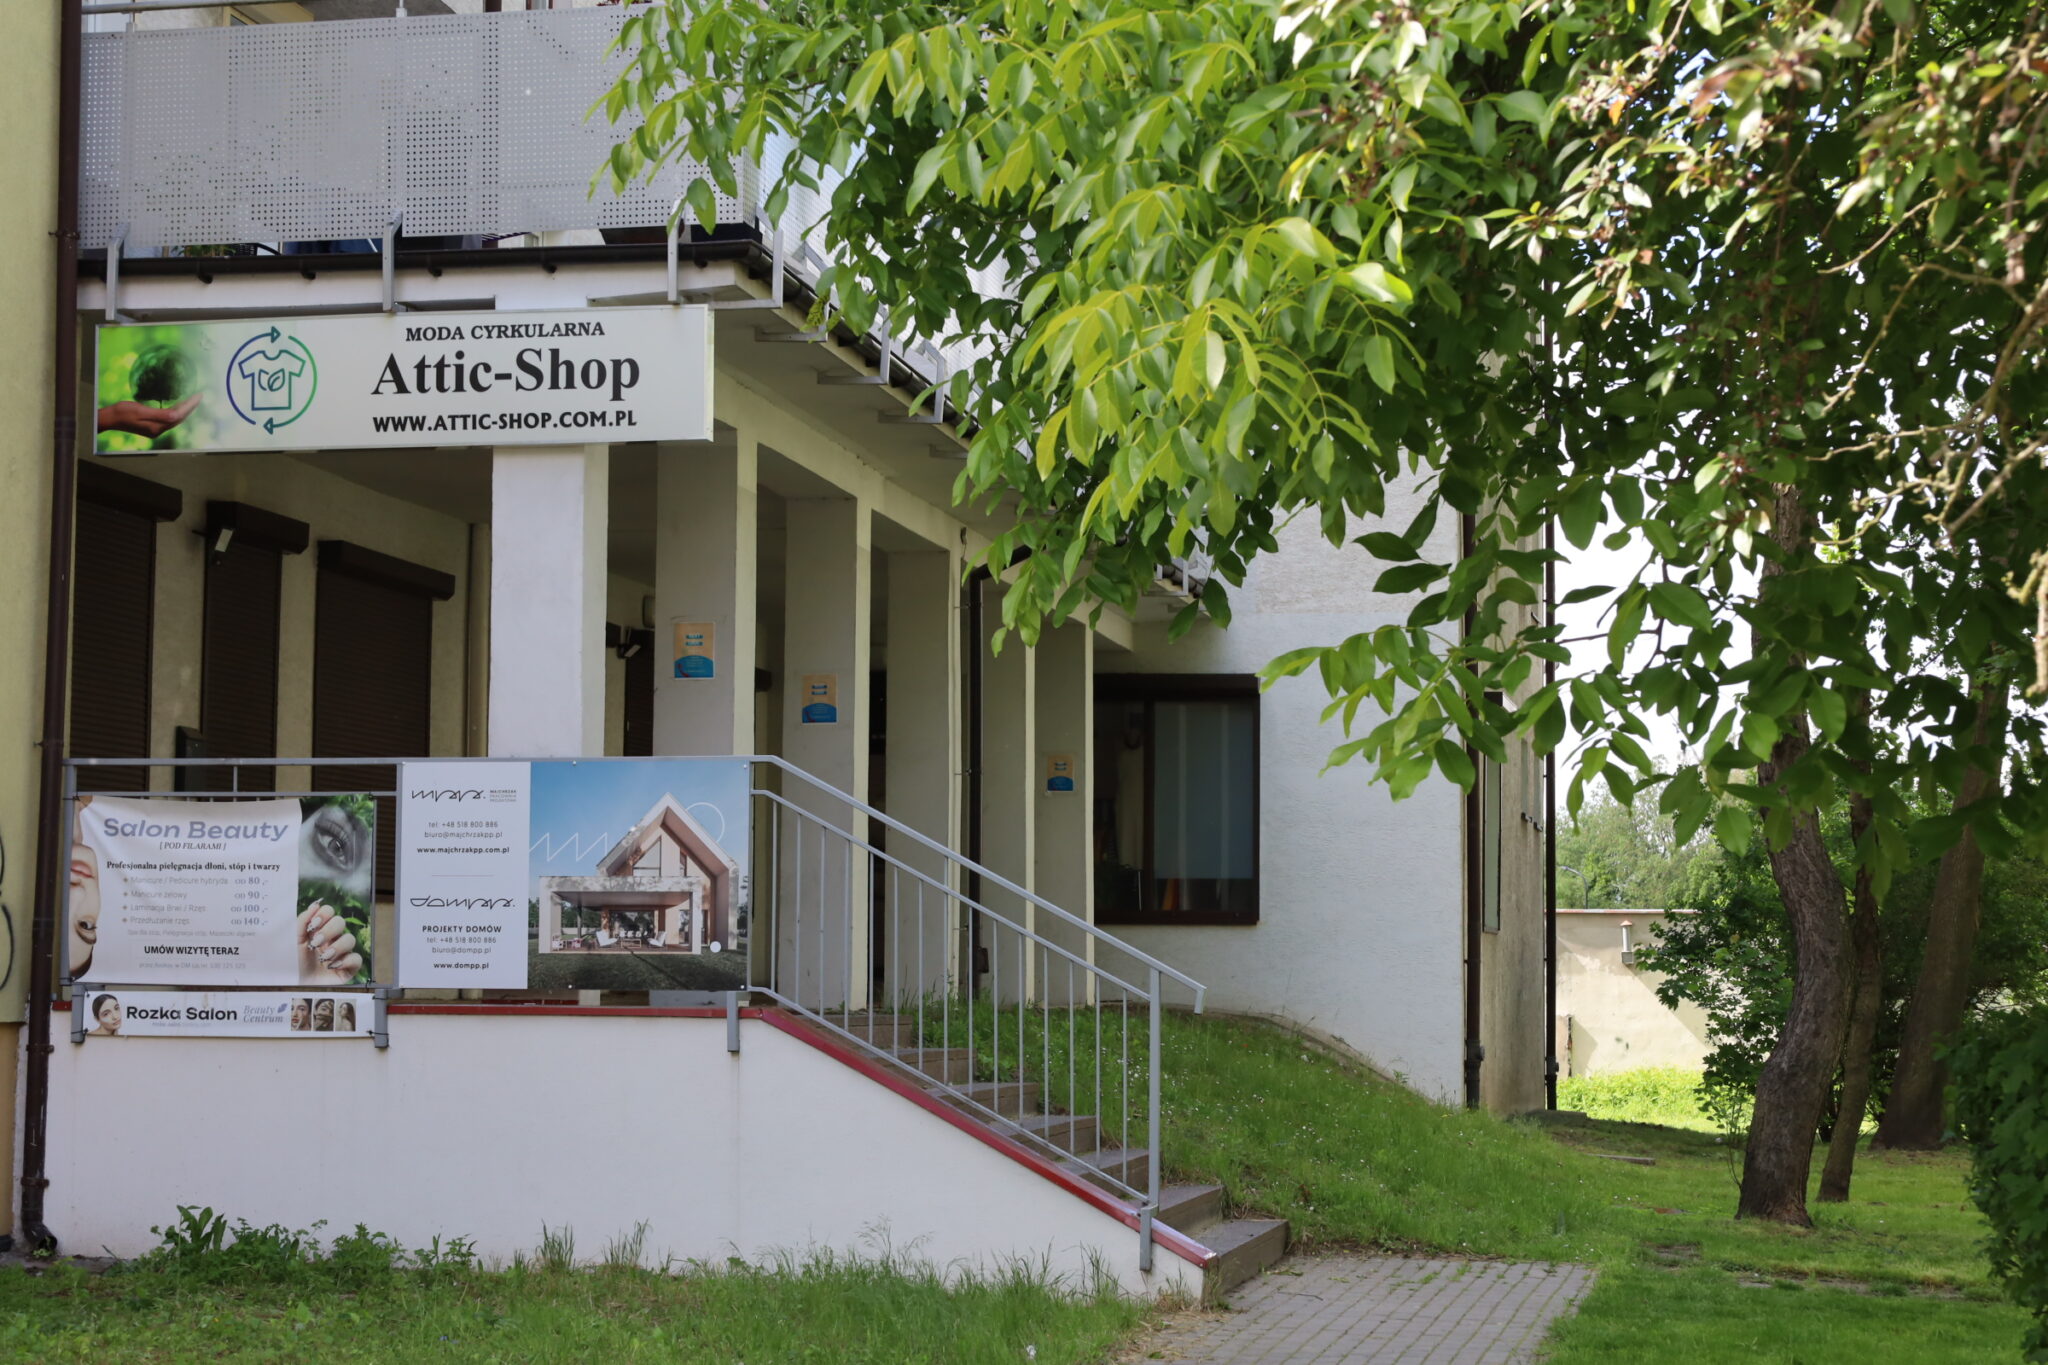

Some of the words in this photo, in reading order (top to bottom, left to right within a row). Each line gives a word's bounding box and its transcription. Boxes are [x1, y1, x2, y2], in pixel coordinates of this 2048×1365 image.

[406, 326, 465, 342] MODA
[470, 322, 606, 340] CYRKULARNA
[370, 347, 641, 402] Attic-Shop
[372, 410, 638, 433] WWW.ATTIC-SHOP.COM.PL
[103, 817, 181, 838] Salon
[187, 820, 289, 842] Beauty
[164, 842, 182, 850] POD
[182, 842, 222, 850] FILARAMI
[417, 846, 510, 854] www.majchrzakpp.com.pl
[106, 861, 157, 871] Profesjonalna
[159, 862, 203, 872] pielęgnacja
[204, 862, 227, 871] dłoni,
[229, 863, 246, 873] stóp
[253, 863, 281, 873] twarzy
[422, 925, 462, 933] PROJEKTY
[465, 924, 502, 933] DOMÓW
[144, 944, 175, 955] UMÓW
[175, 946, 210, 957] WIZYTĘ
[210, 947, 240, 956] TERAZ
[433, 963, 490, 971] www.dompp.pl
[126, 1006, 181, 1020] Rozka
[186, 1007, 238, 1021] Salon
[243, 1015, 284, 1024] Centrum
